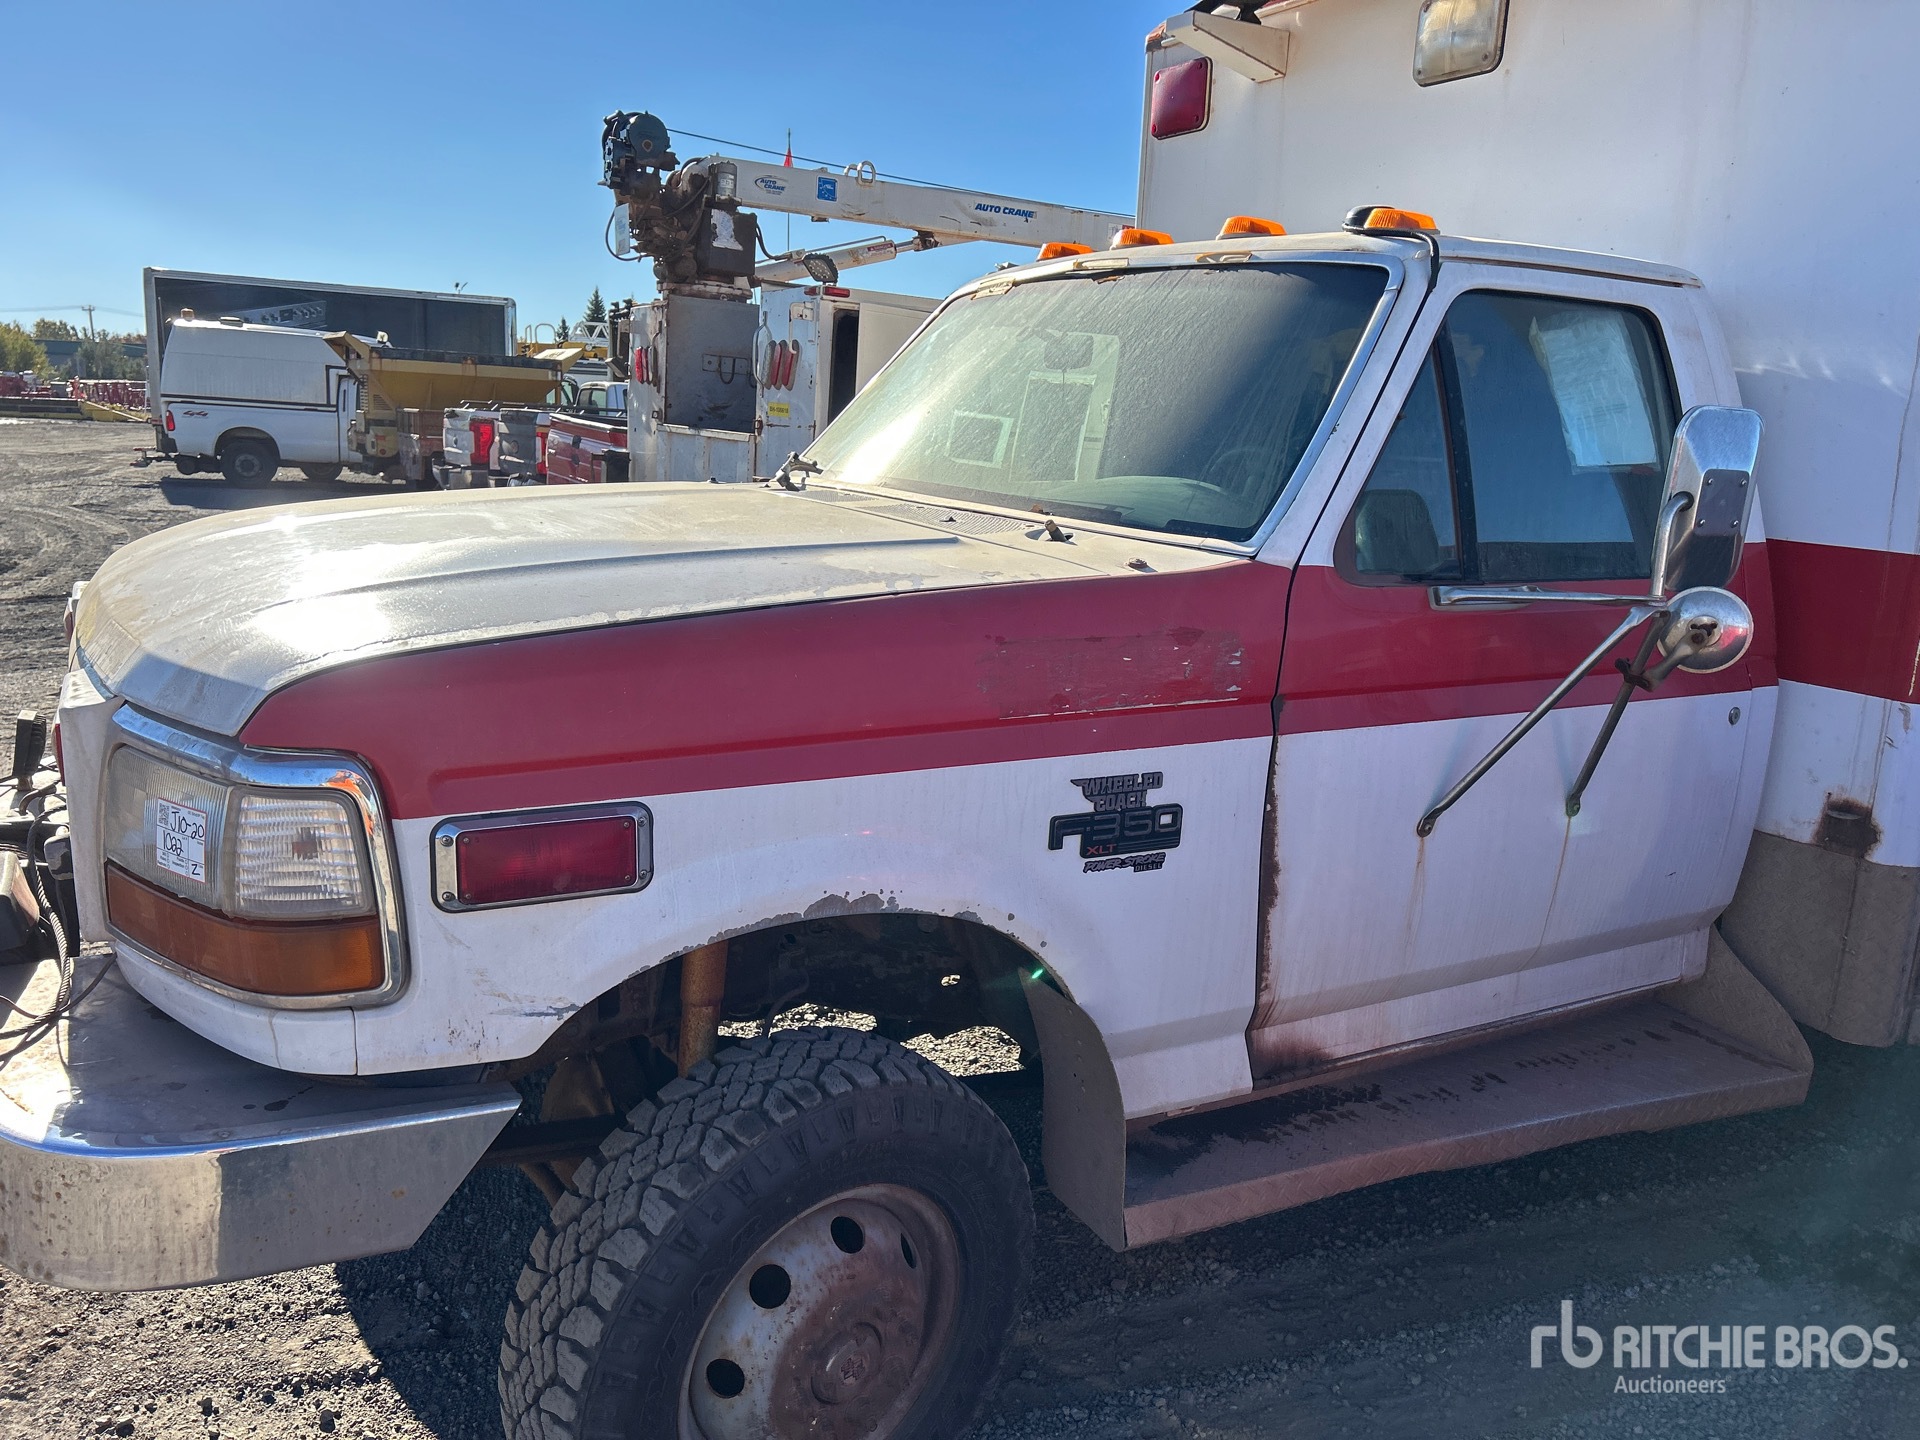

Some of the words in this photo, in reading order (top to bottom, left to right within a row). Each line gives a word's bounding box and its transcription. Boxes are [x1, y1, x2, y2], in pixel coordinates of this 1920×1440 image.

[975, 203, 1001, 213] AUTO
[1003, 207, 1034, 218] CRANE
[1071, 771, 1163, 796] WHEELED
[1088, 790, 1147, 811] COACH
[170, 811, 205, 839] J10-20
[163, 830, 184, 856] 1022
[1086, 843, 1117, 856] XLT
[1083, 856, 1122, 873] POWER
[1123, 852, 1166, 867] STROKE
[1134, 862, 1163, 872] DIESEL
